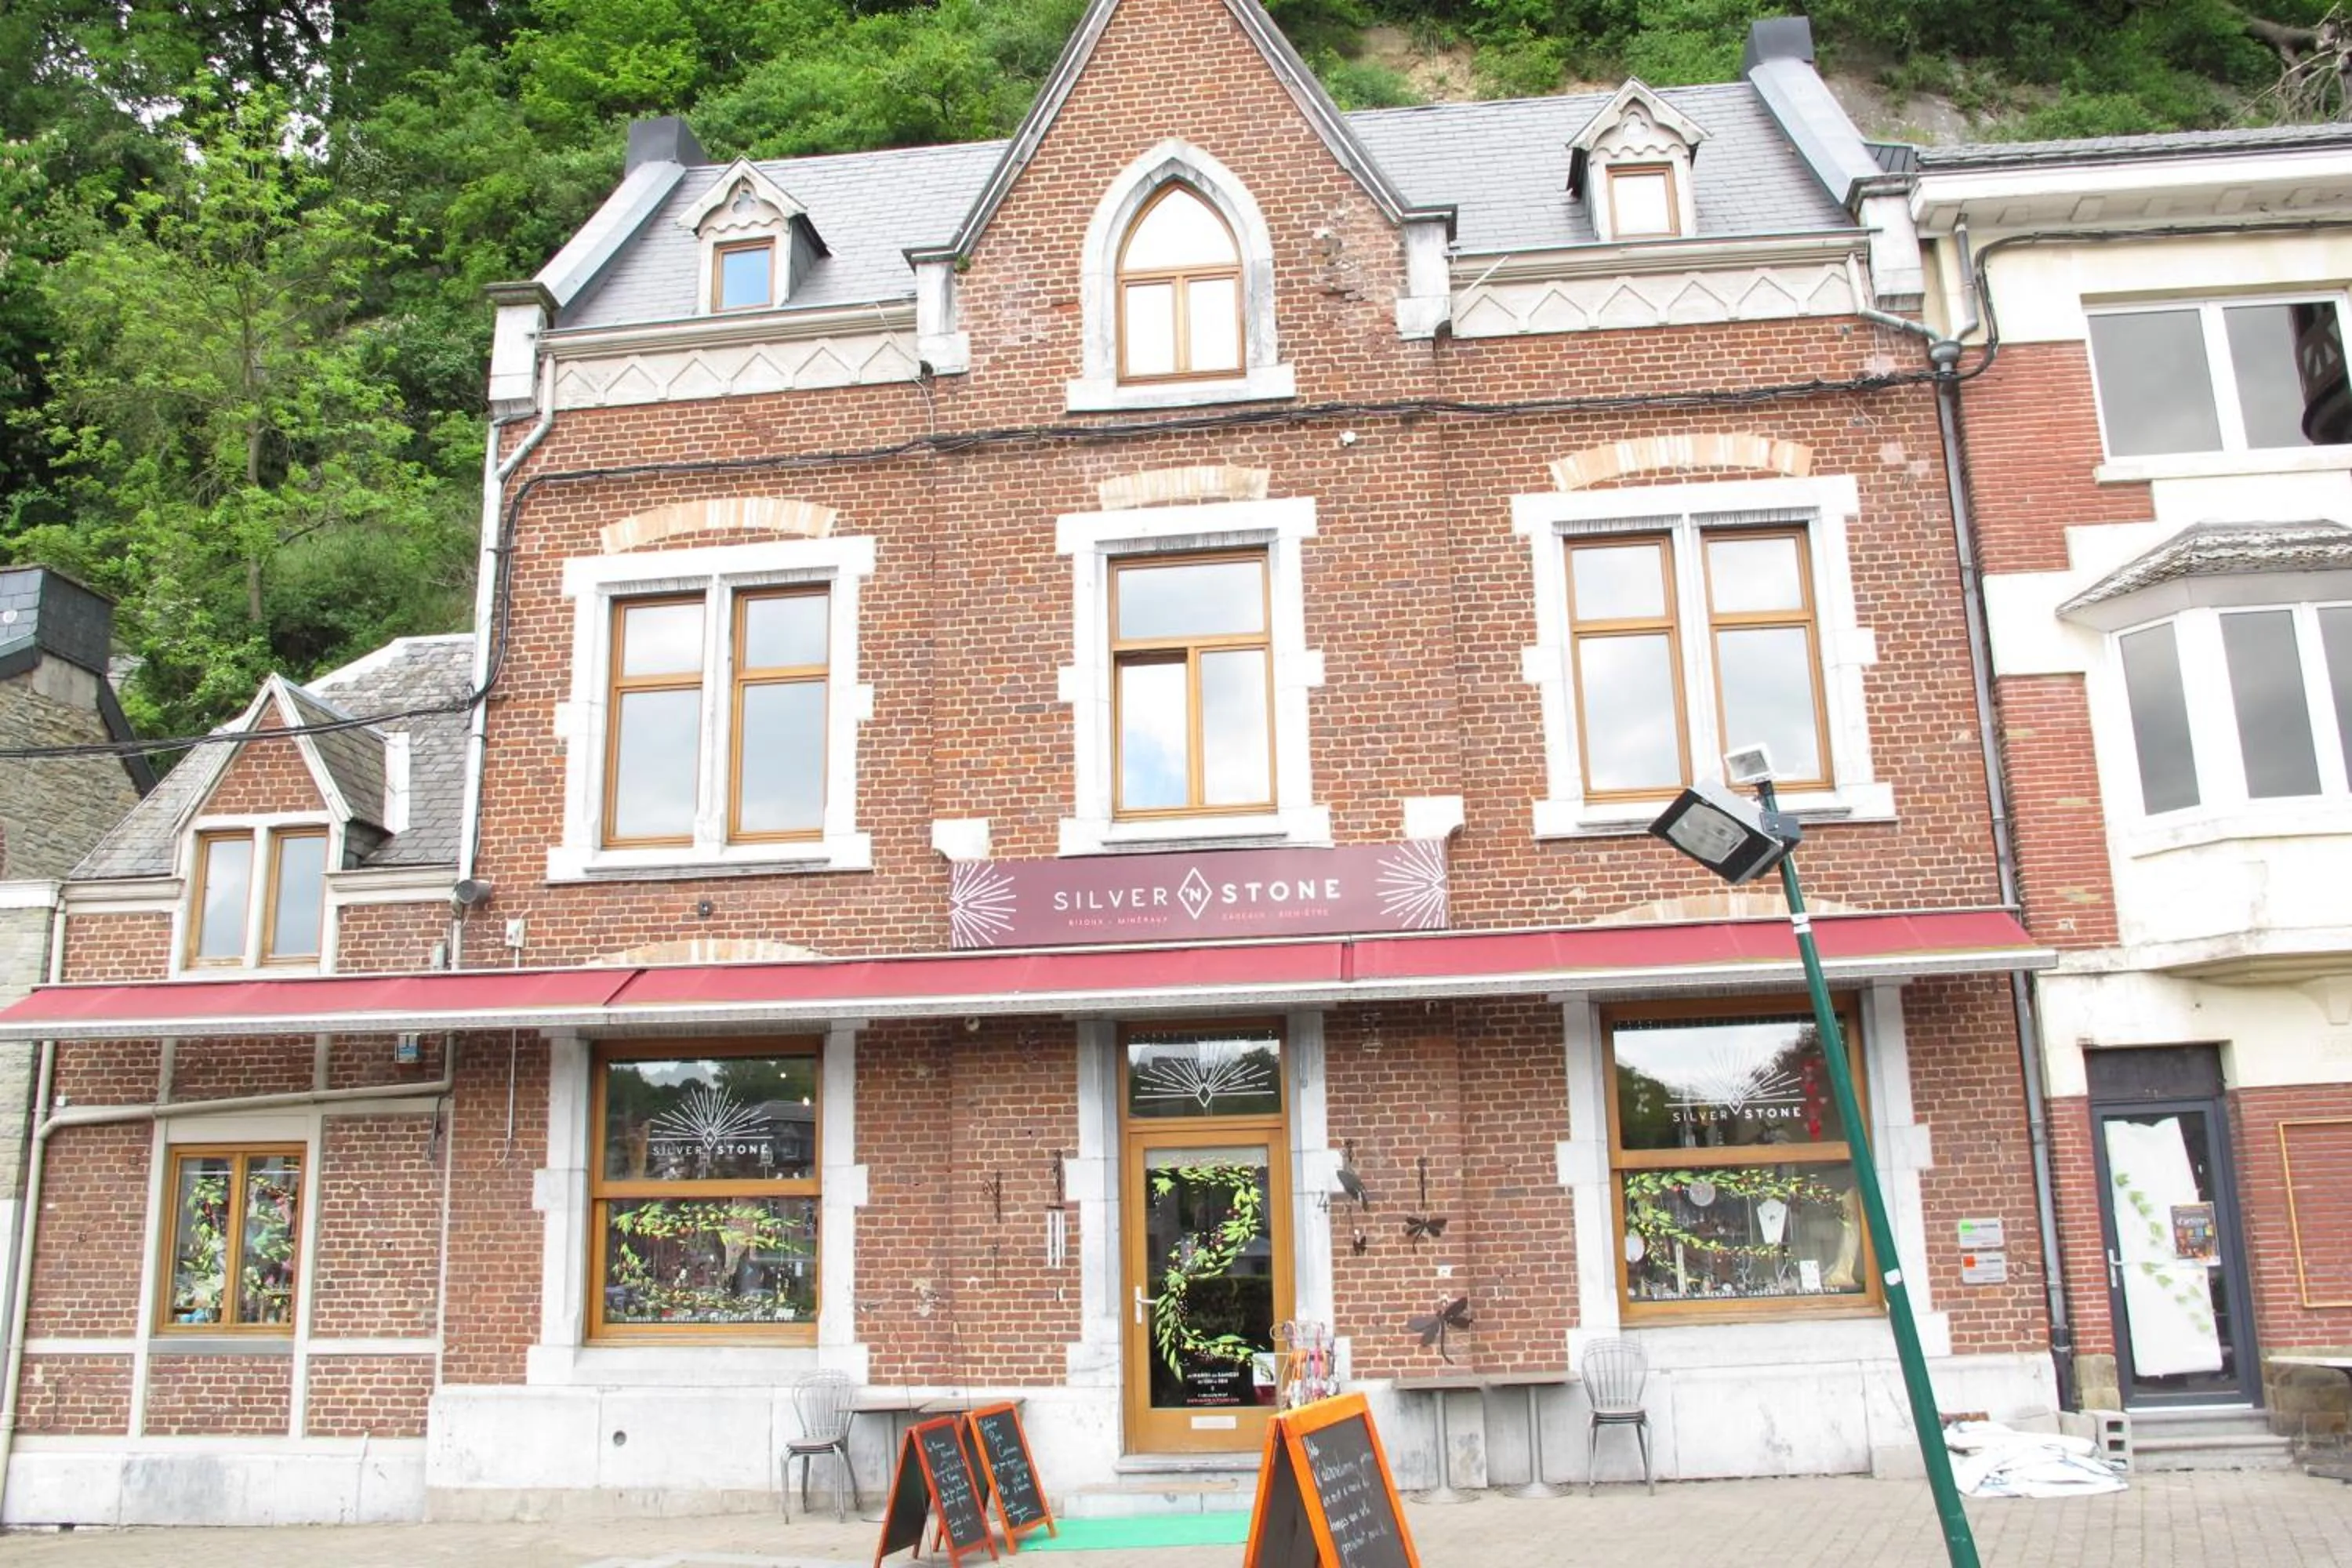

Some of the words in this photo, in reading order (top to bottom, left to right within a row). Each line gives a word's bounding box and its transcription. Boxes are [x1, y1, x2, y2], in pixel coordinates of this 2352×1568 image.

[1053, 887, 1168, 911] SILVER
[1221, 878, 1341, 904] STONE
[1672, 1110, 1728, 1122] SILVER
[1744, 1106, 1802, 1120] STONE
[652, 1145, 702, 1156] SILVER
[717, 1143, 768, 1155] STONE
